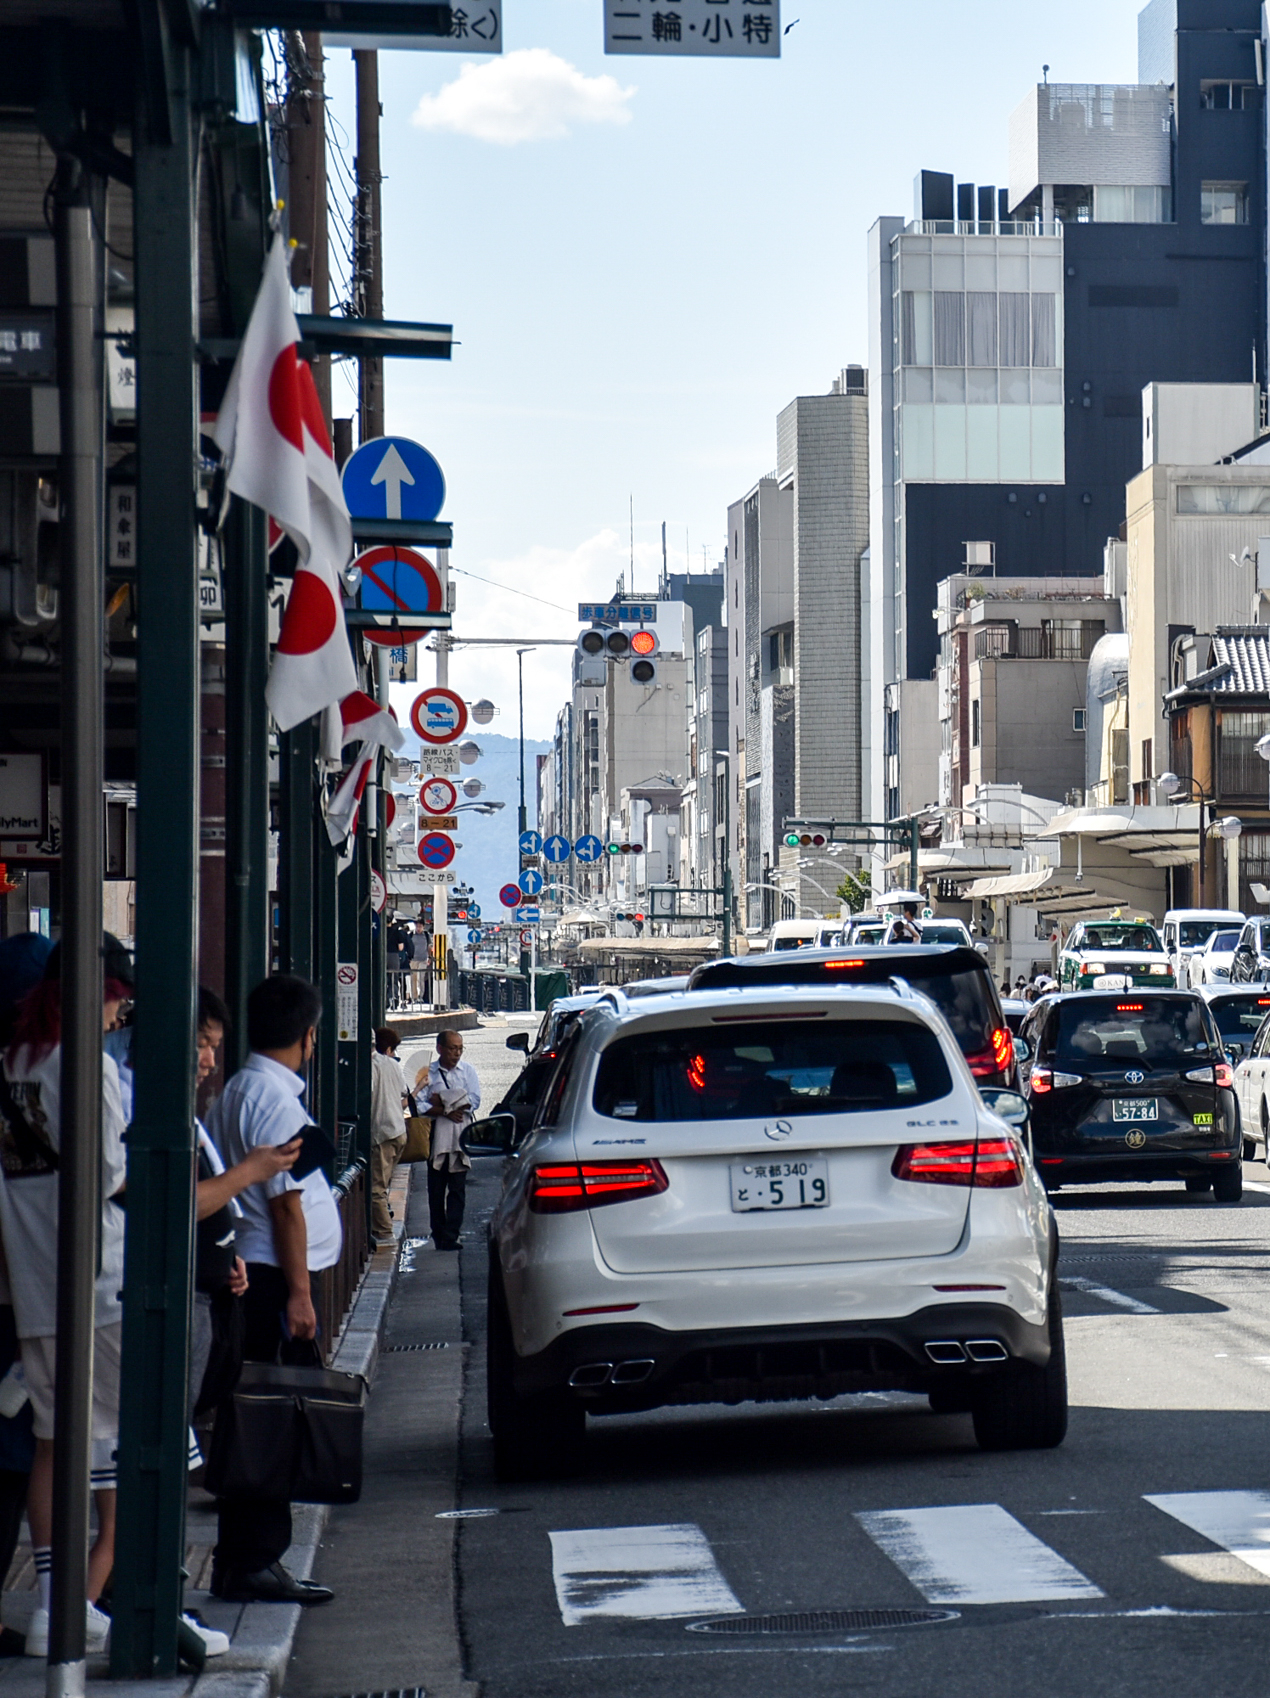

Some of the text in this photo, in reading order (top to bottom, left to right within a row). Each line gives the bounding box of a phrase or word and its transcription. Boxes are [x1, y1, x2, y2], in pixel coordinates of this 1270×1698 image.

[611, 12, 773, 45] 二輪・小特
[419, 873, 454, 882] ここから
[1194, 1115, 1212, 1124] TAXI
[738, 1188, 749, 1201] と
